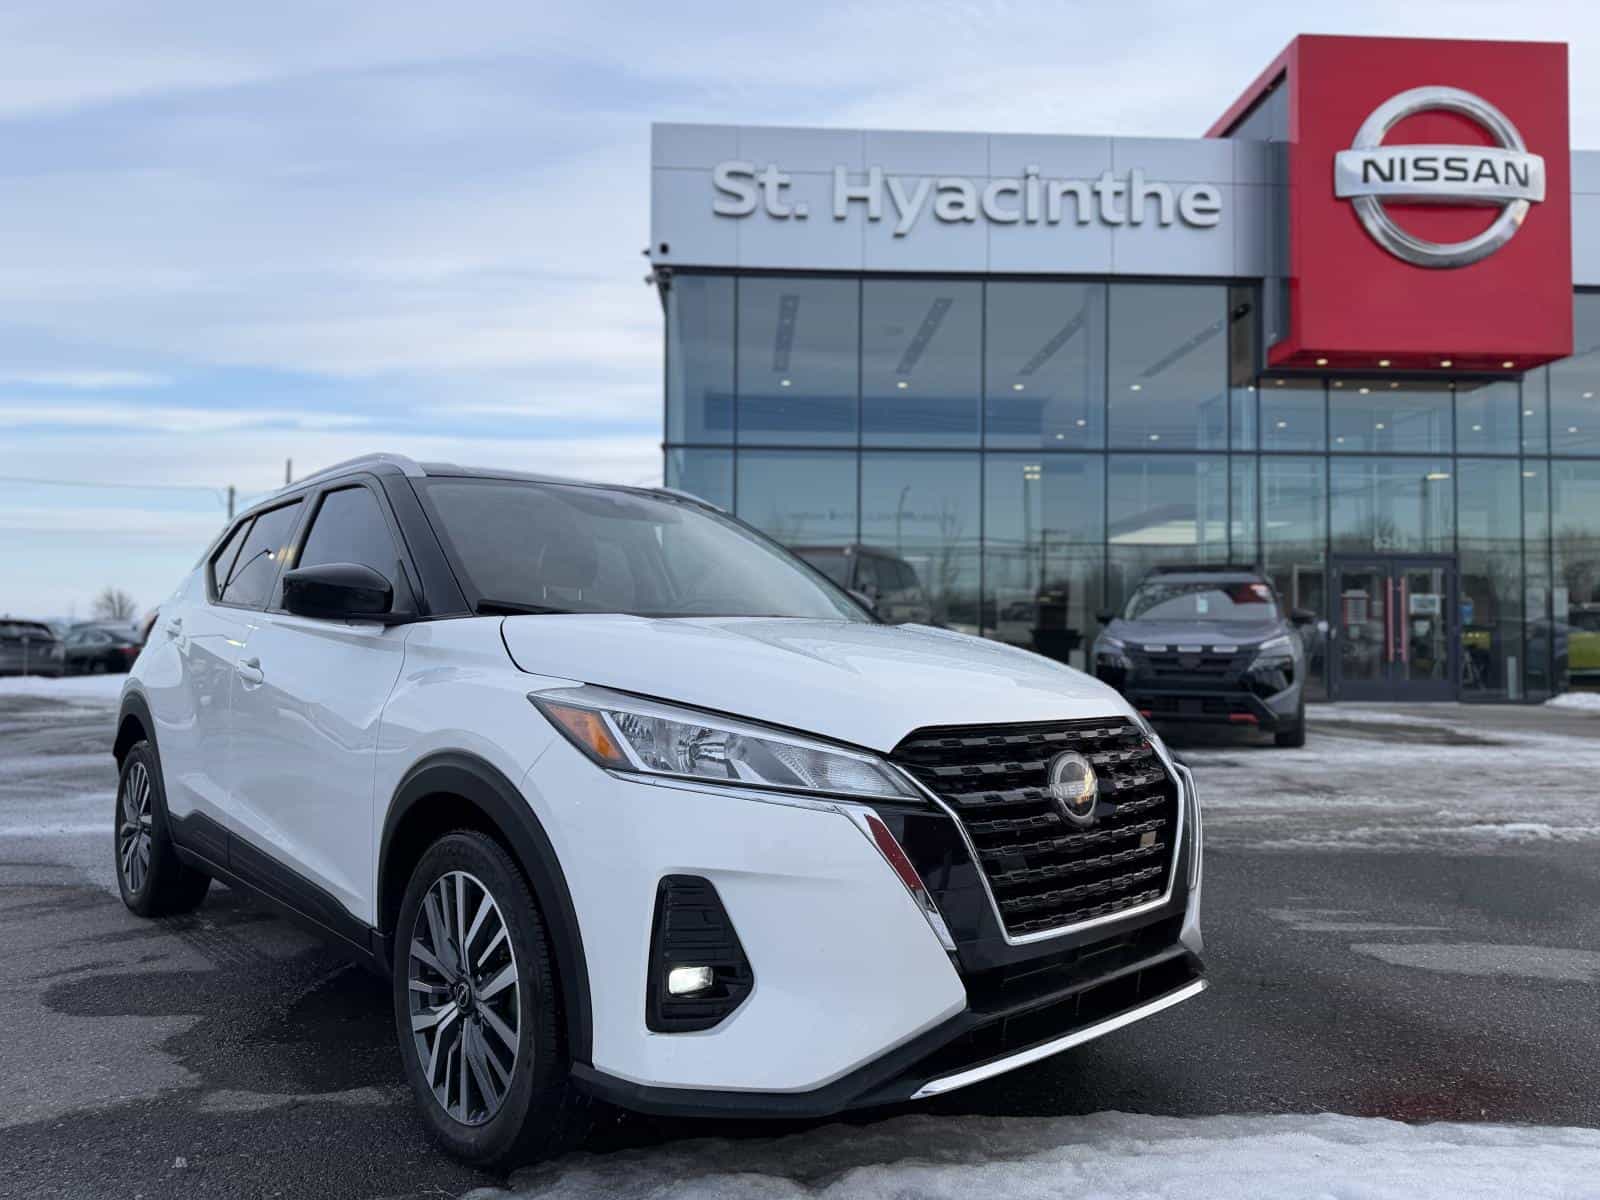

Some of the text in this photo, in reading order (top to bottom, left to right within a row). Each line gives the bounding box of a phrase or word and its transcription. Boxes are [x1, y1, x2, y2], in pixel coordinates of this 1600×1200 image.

[1362, 157, 1529, 187] NISSAN
[711, 161, 1221, 237] St. Hyacinthe
